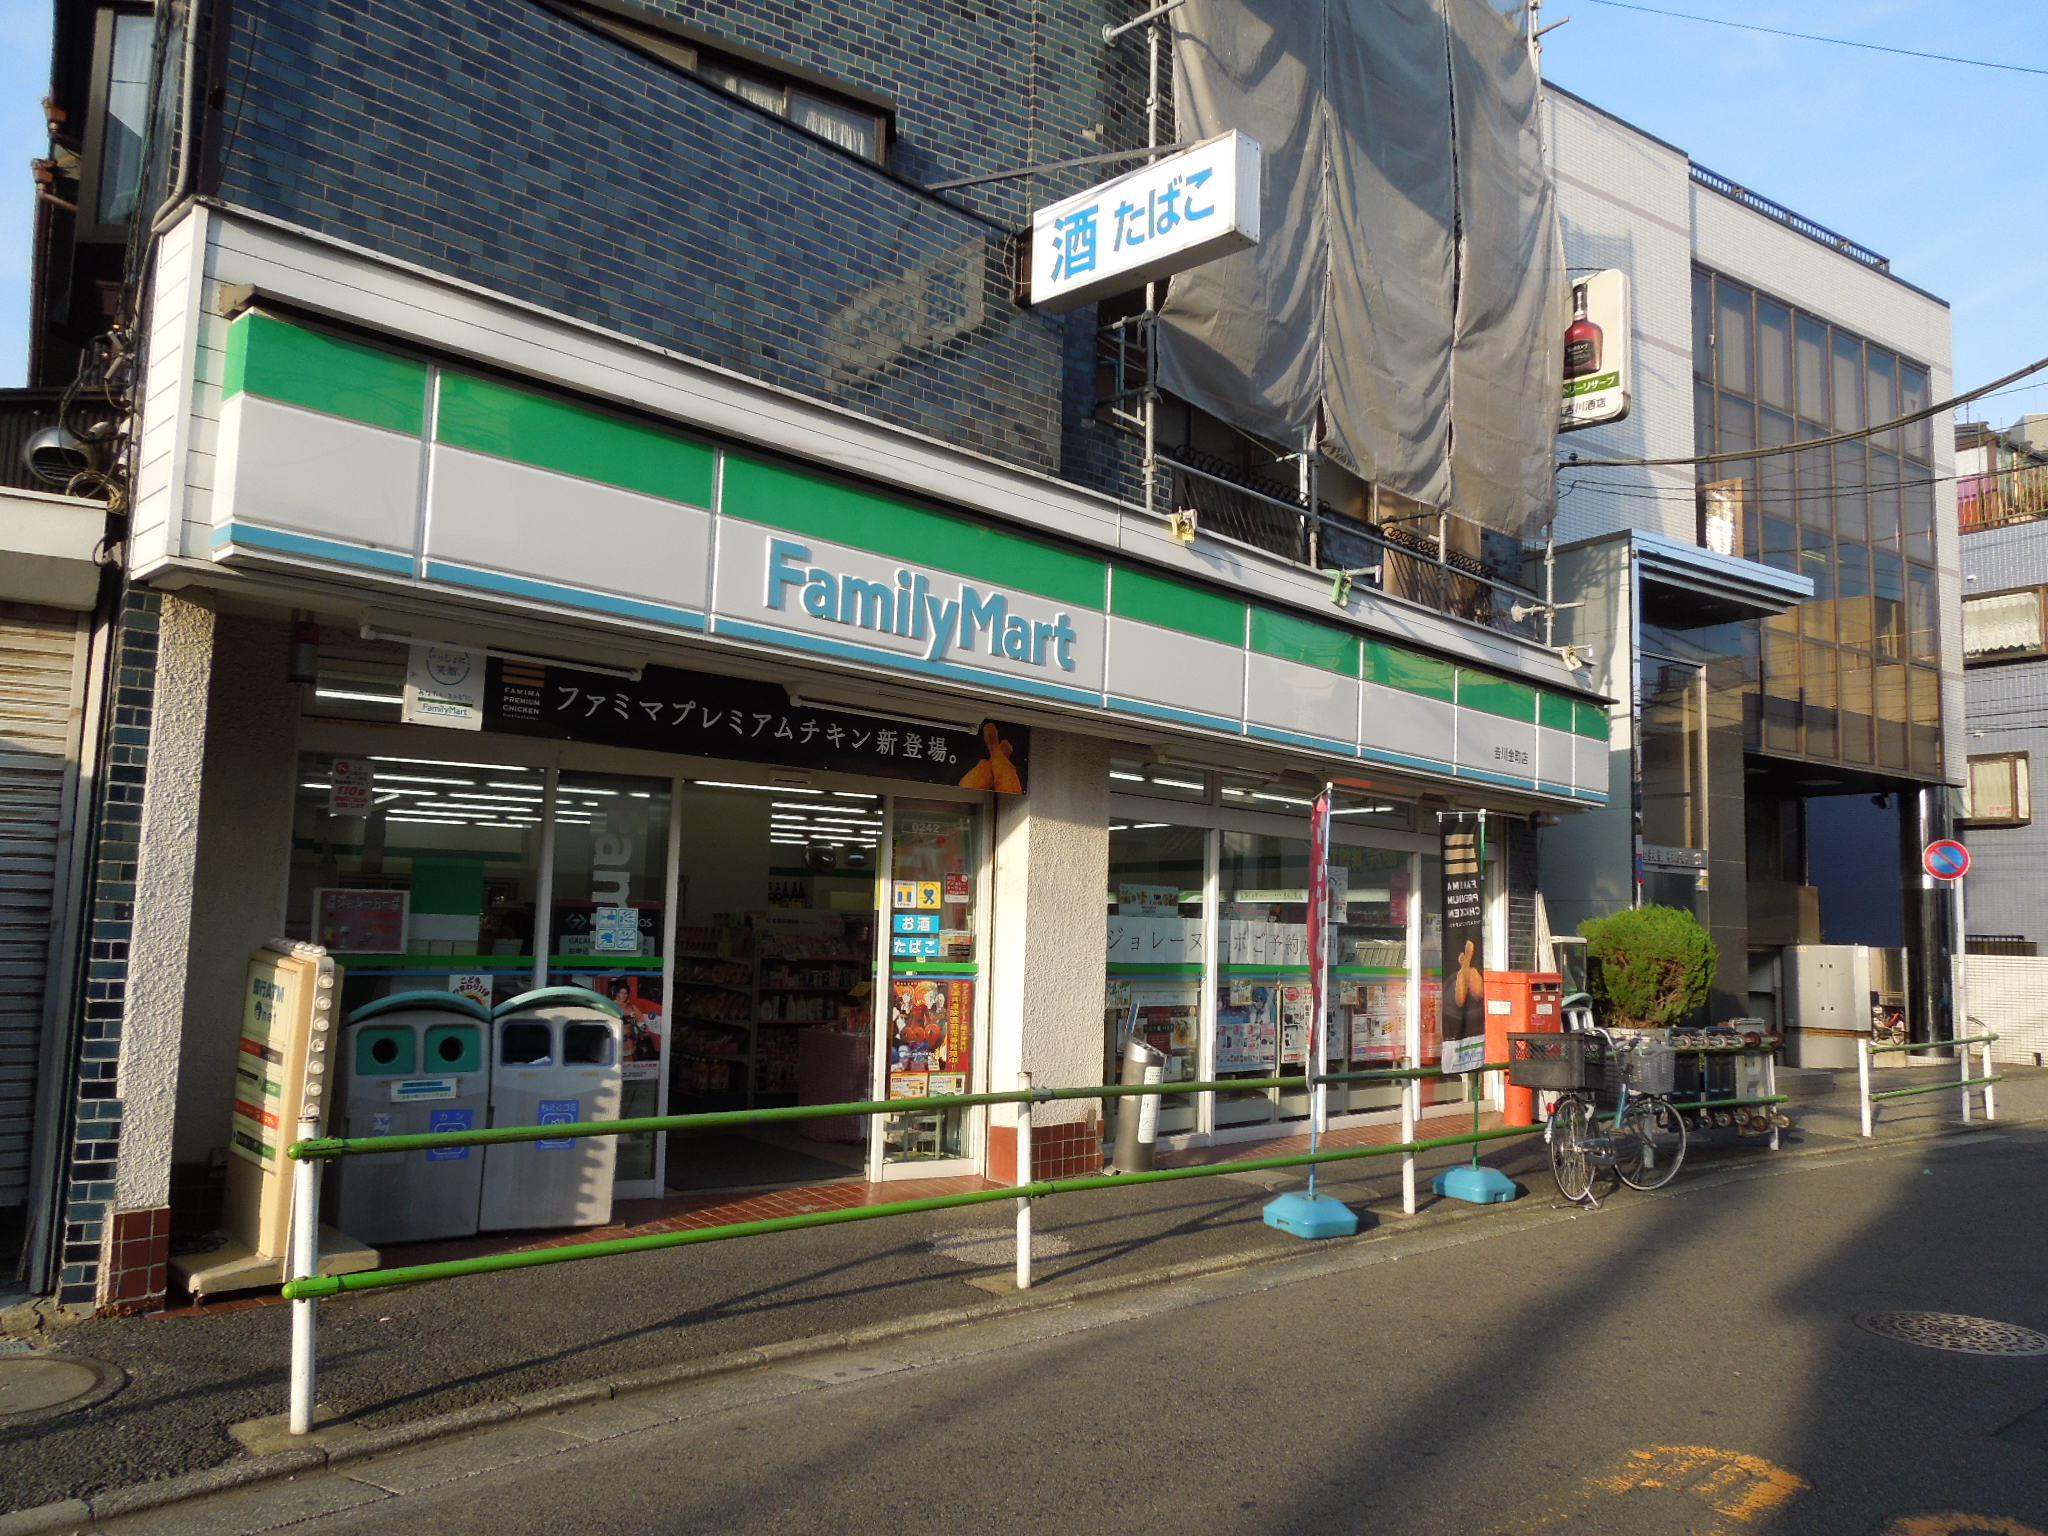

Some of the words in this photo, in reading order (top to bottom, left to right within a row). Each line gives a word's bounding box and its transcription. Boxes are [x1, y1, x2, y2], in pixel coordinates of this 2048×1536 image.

[1050, 203, 1099, 283] 酒
[1113, 167, 1215, 252] たばこ
[763, 534, 1077, 673] FamilyMart
[504, 687, 540, 698] FAMIMA
[503, 696, 541, 707] PREMIUM
[422, 703, 468, 716] FamilyMart
[502, 704, 540, 715] CHICKEN
[556, 685, 958, 766] ファミマプレミアムチキン新登場。
[901, 916, 931, 931] お酒
[894, 939, 936, 954] たばこ
